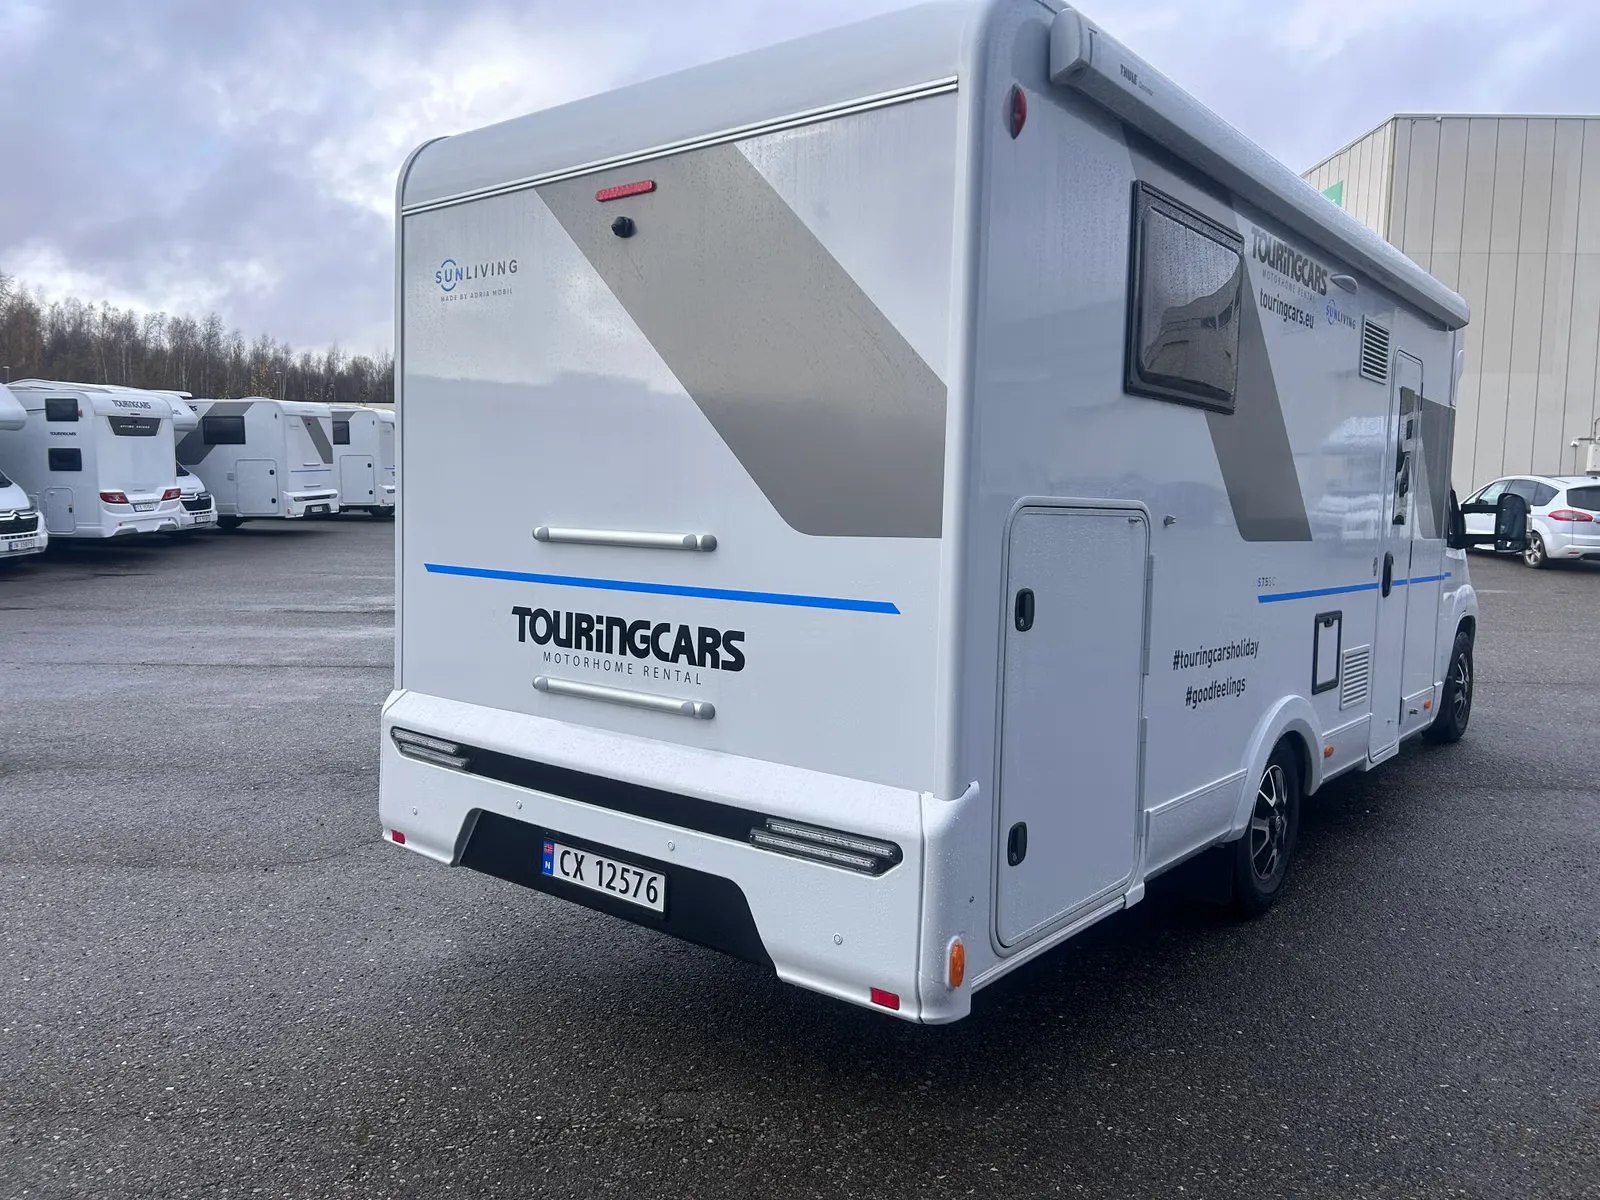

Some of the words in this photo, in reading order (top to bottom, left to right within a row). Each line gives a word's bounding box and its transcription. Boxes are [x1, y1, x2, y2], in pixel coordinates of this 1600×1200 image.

[1120, 64, 1137, 85] THULE
[435, 259, 518, 284] SUNLIVING
[1262, 269, 1295, 294] MOTORHOME
[1298, 286, 1316, 302] RENTAL
[441, 294, 457, 302] MADE
[470, 290, 490, 298] ADRIA
[492, 288, 513, 296] MOBIL
[1260, 288, 1314, 329] touringcars.eu
[1326, 303, 1356, 330] SUNLIVING
[543, 651, 633, 675] MOTORHOME
[643, 665, 702, 686] RENTAL
[1172, 637, 1259, 670] #touringcarsholiday
[1185, 676, 1246, 709] #goodfeelings
[544, 860, 551, 870] N
[559, 849, 585, 881] CX
[595, 860, 658, 904] 12576
